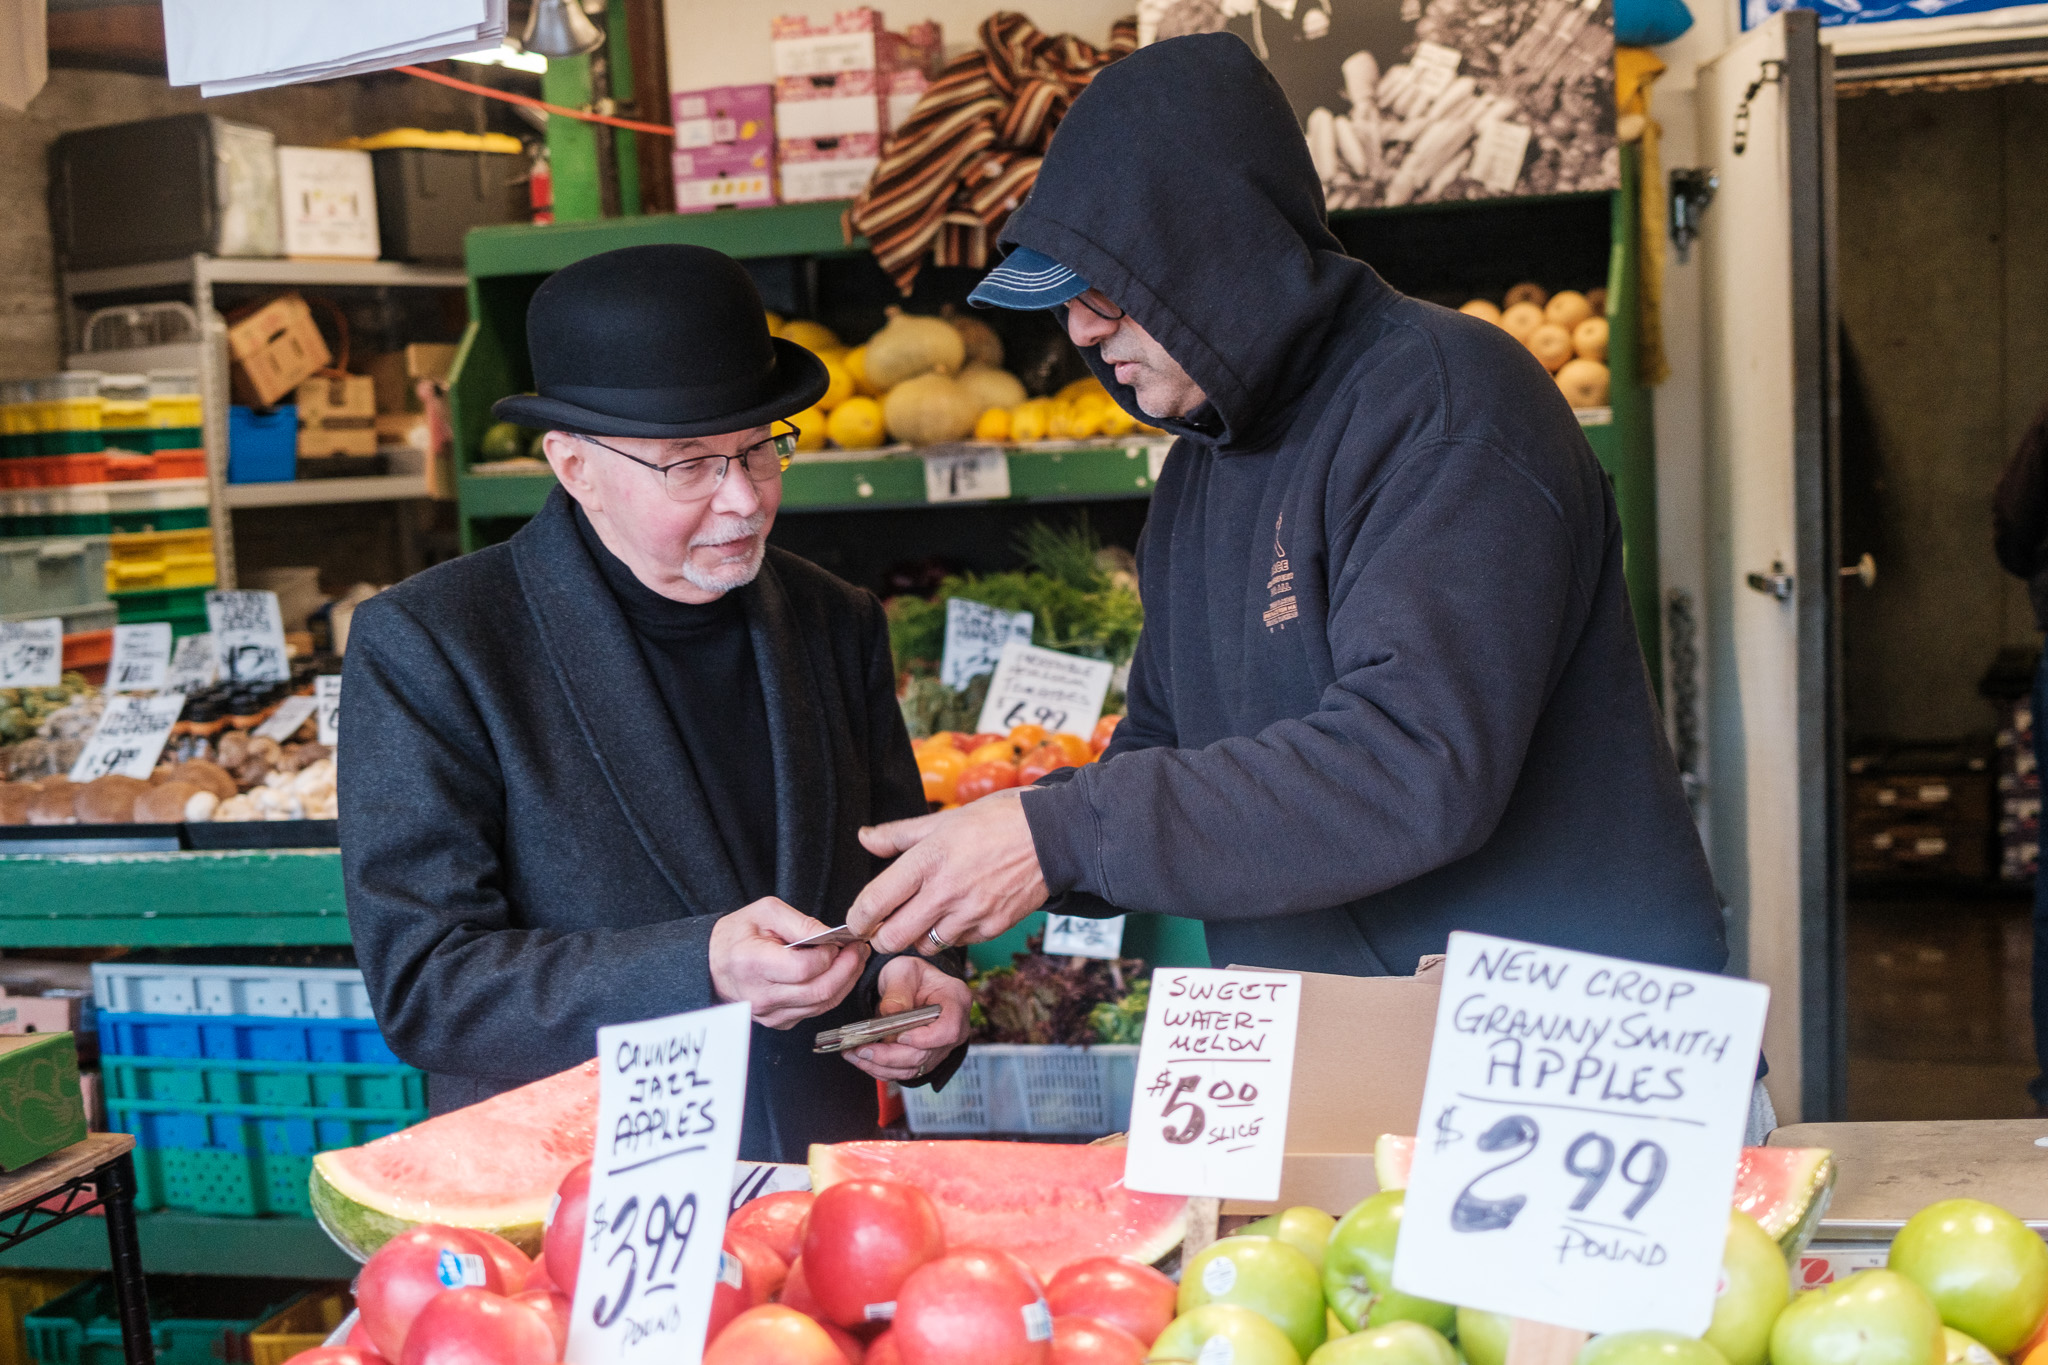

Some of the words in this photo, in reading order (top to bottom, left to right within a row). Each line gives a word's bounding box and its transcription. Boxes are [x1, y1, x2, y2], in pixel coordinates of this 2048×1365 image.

[1169, 976, 1287, 1002] SWEET
[1467, 947, 1570, 991] NEW
[1584, 969, 1696, 1011] CROP
[1163, 1009, 1273, 1031] WATER-
[1453, 993, 1612, 1059] GRANNY
[1614, 1012, 1732, 1064] SMITH
[616, 1027, 707, 1073] CRUNCHY
[1169, 1033, 1267, 1053] MELON
[630, 1070, 711, 1103] JAZZ
[1487, 1037, 1686, 1103] APPLES
[612, 1099, 715, 1157] APPLES
[1207, 1117, 1264, 1145] SLICE
[1556, 1225, 1668, 1266] POUND
